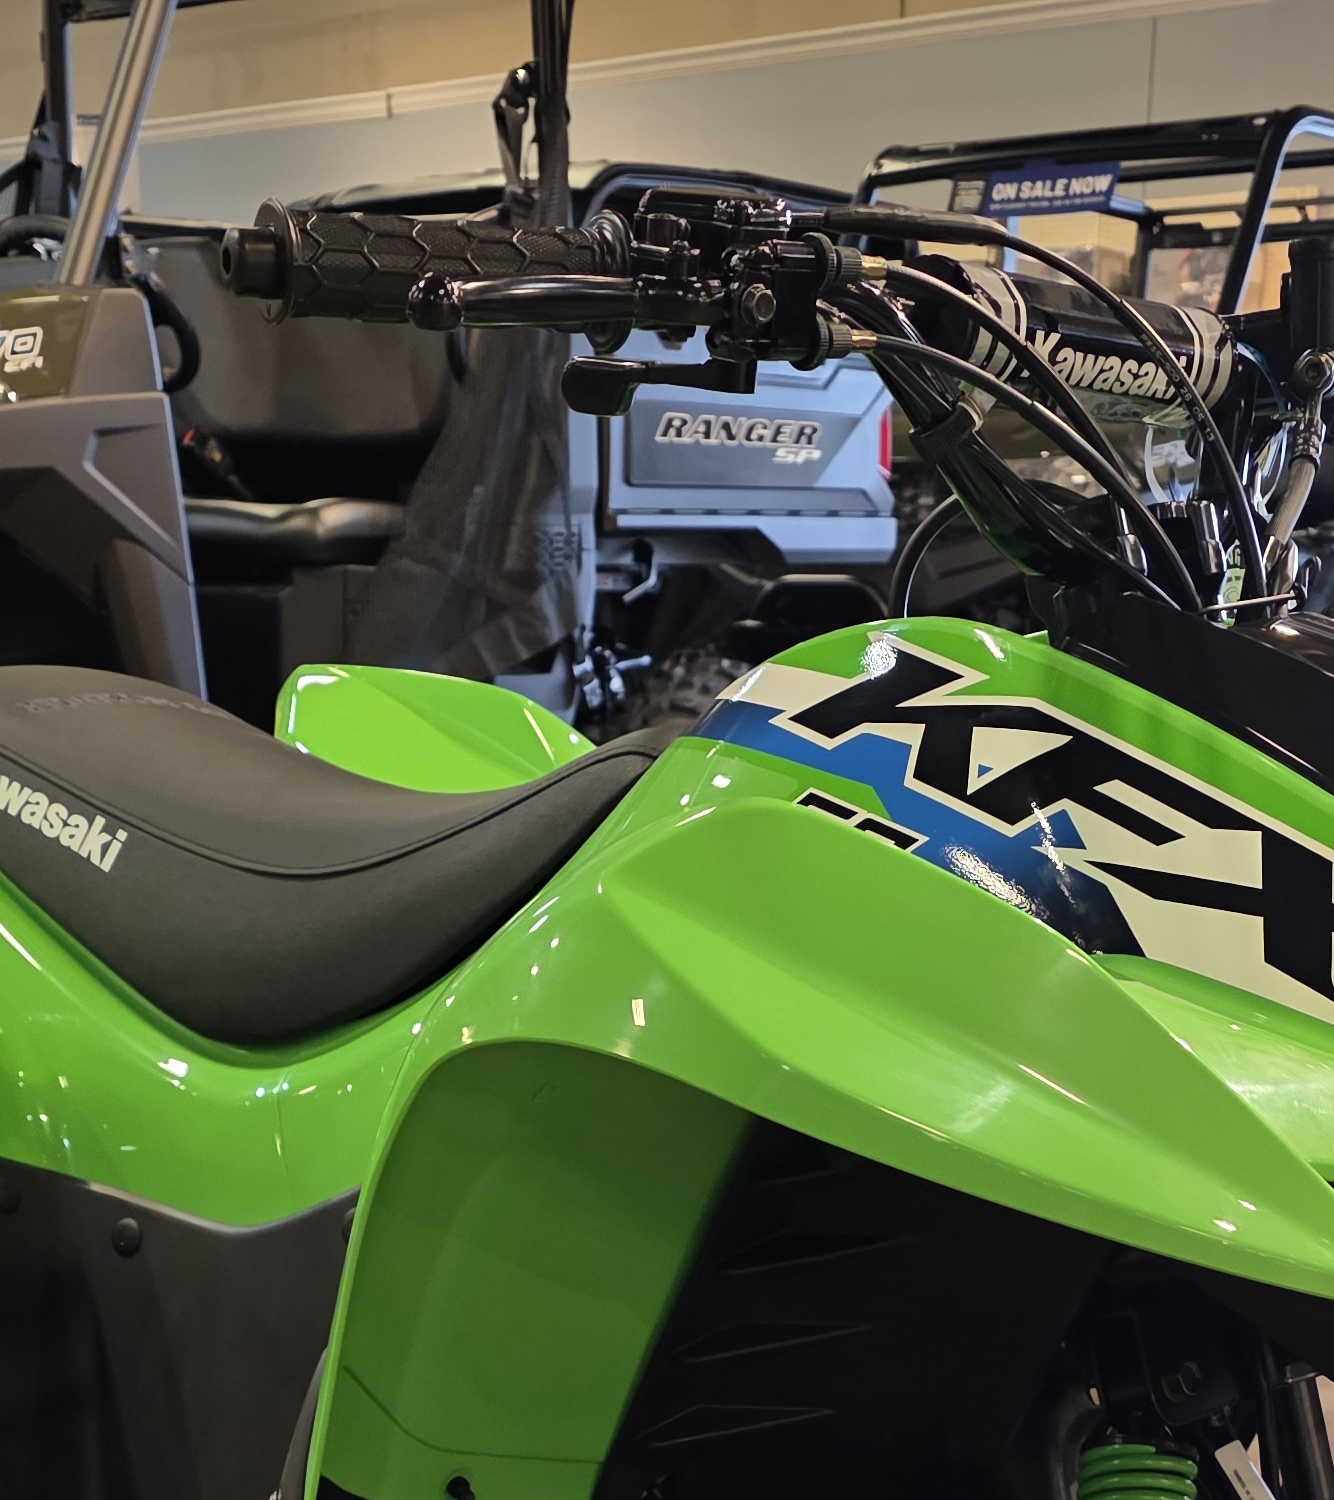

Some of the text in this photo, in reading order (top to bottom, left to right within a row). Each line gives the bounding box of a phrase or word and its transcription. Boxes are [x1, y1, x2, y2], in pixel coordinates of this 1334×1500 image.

[991, 181, 1019, 202] ON
[1019, 178, 1069, 200] SALE
[1069, 173, 1114, 195] NOW
[654, 411, 823, 448] RANGER
[771, 447, 823, 465] SP
